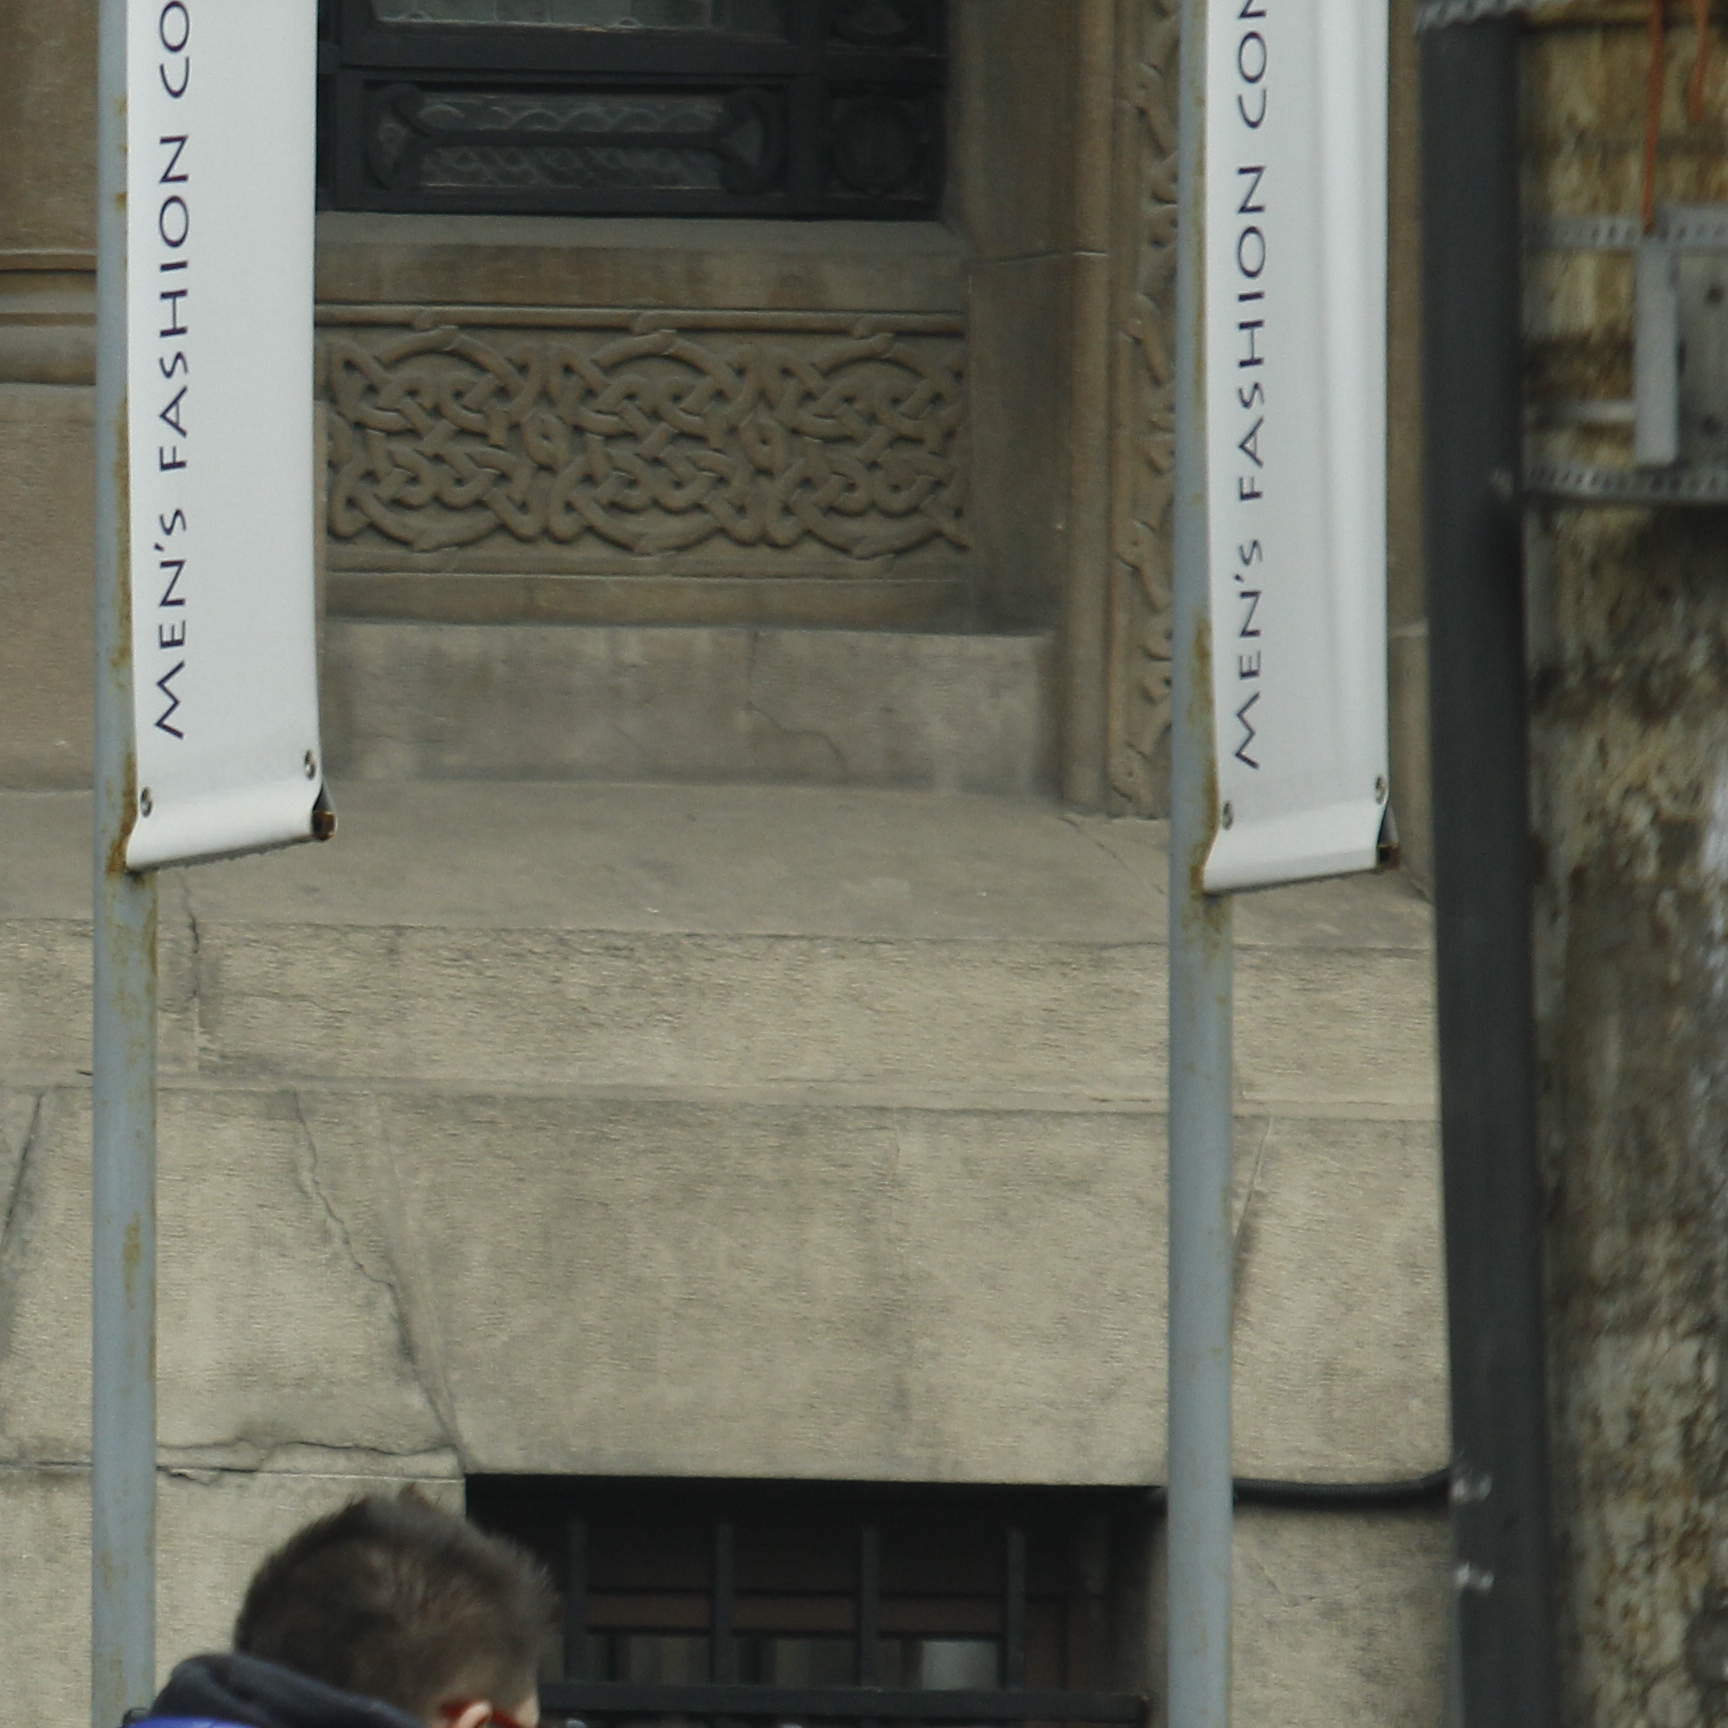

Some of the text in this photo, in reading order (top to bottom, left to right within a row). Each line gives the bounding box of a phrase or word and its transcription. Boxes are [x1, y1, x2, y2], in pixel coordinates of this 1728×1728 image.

[153, 0, 190, 740] MEN'S FASHION CO
[1236, 165, 1266, 502] FASHION
[1233, 539, 1263, 770] MEN'S
